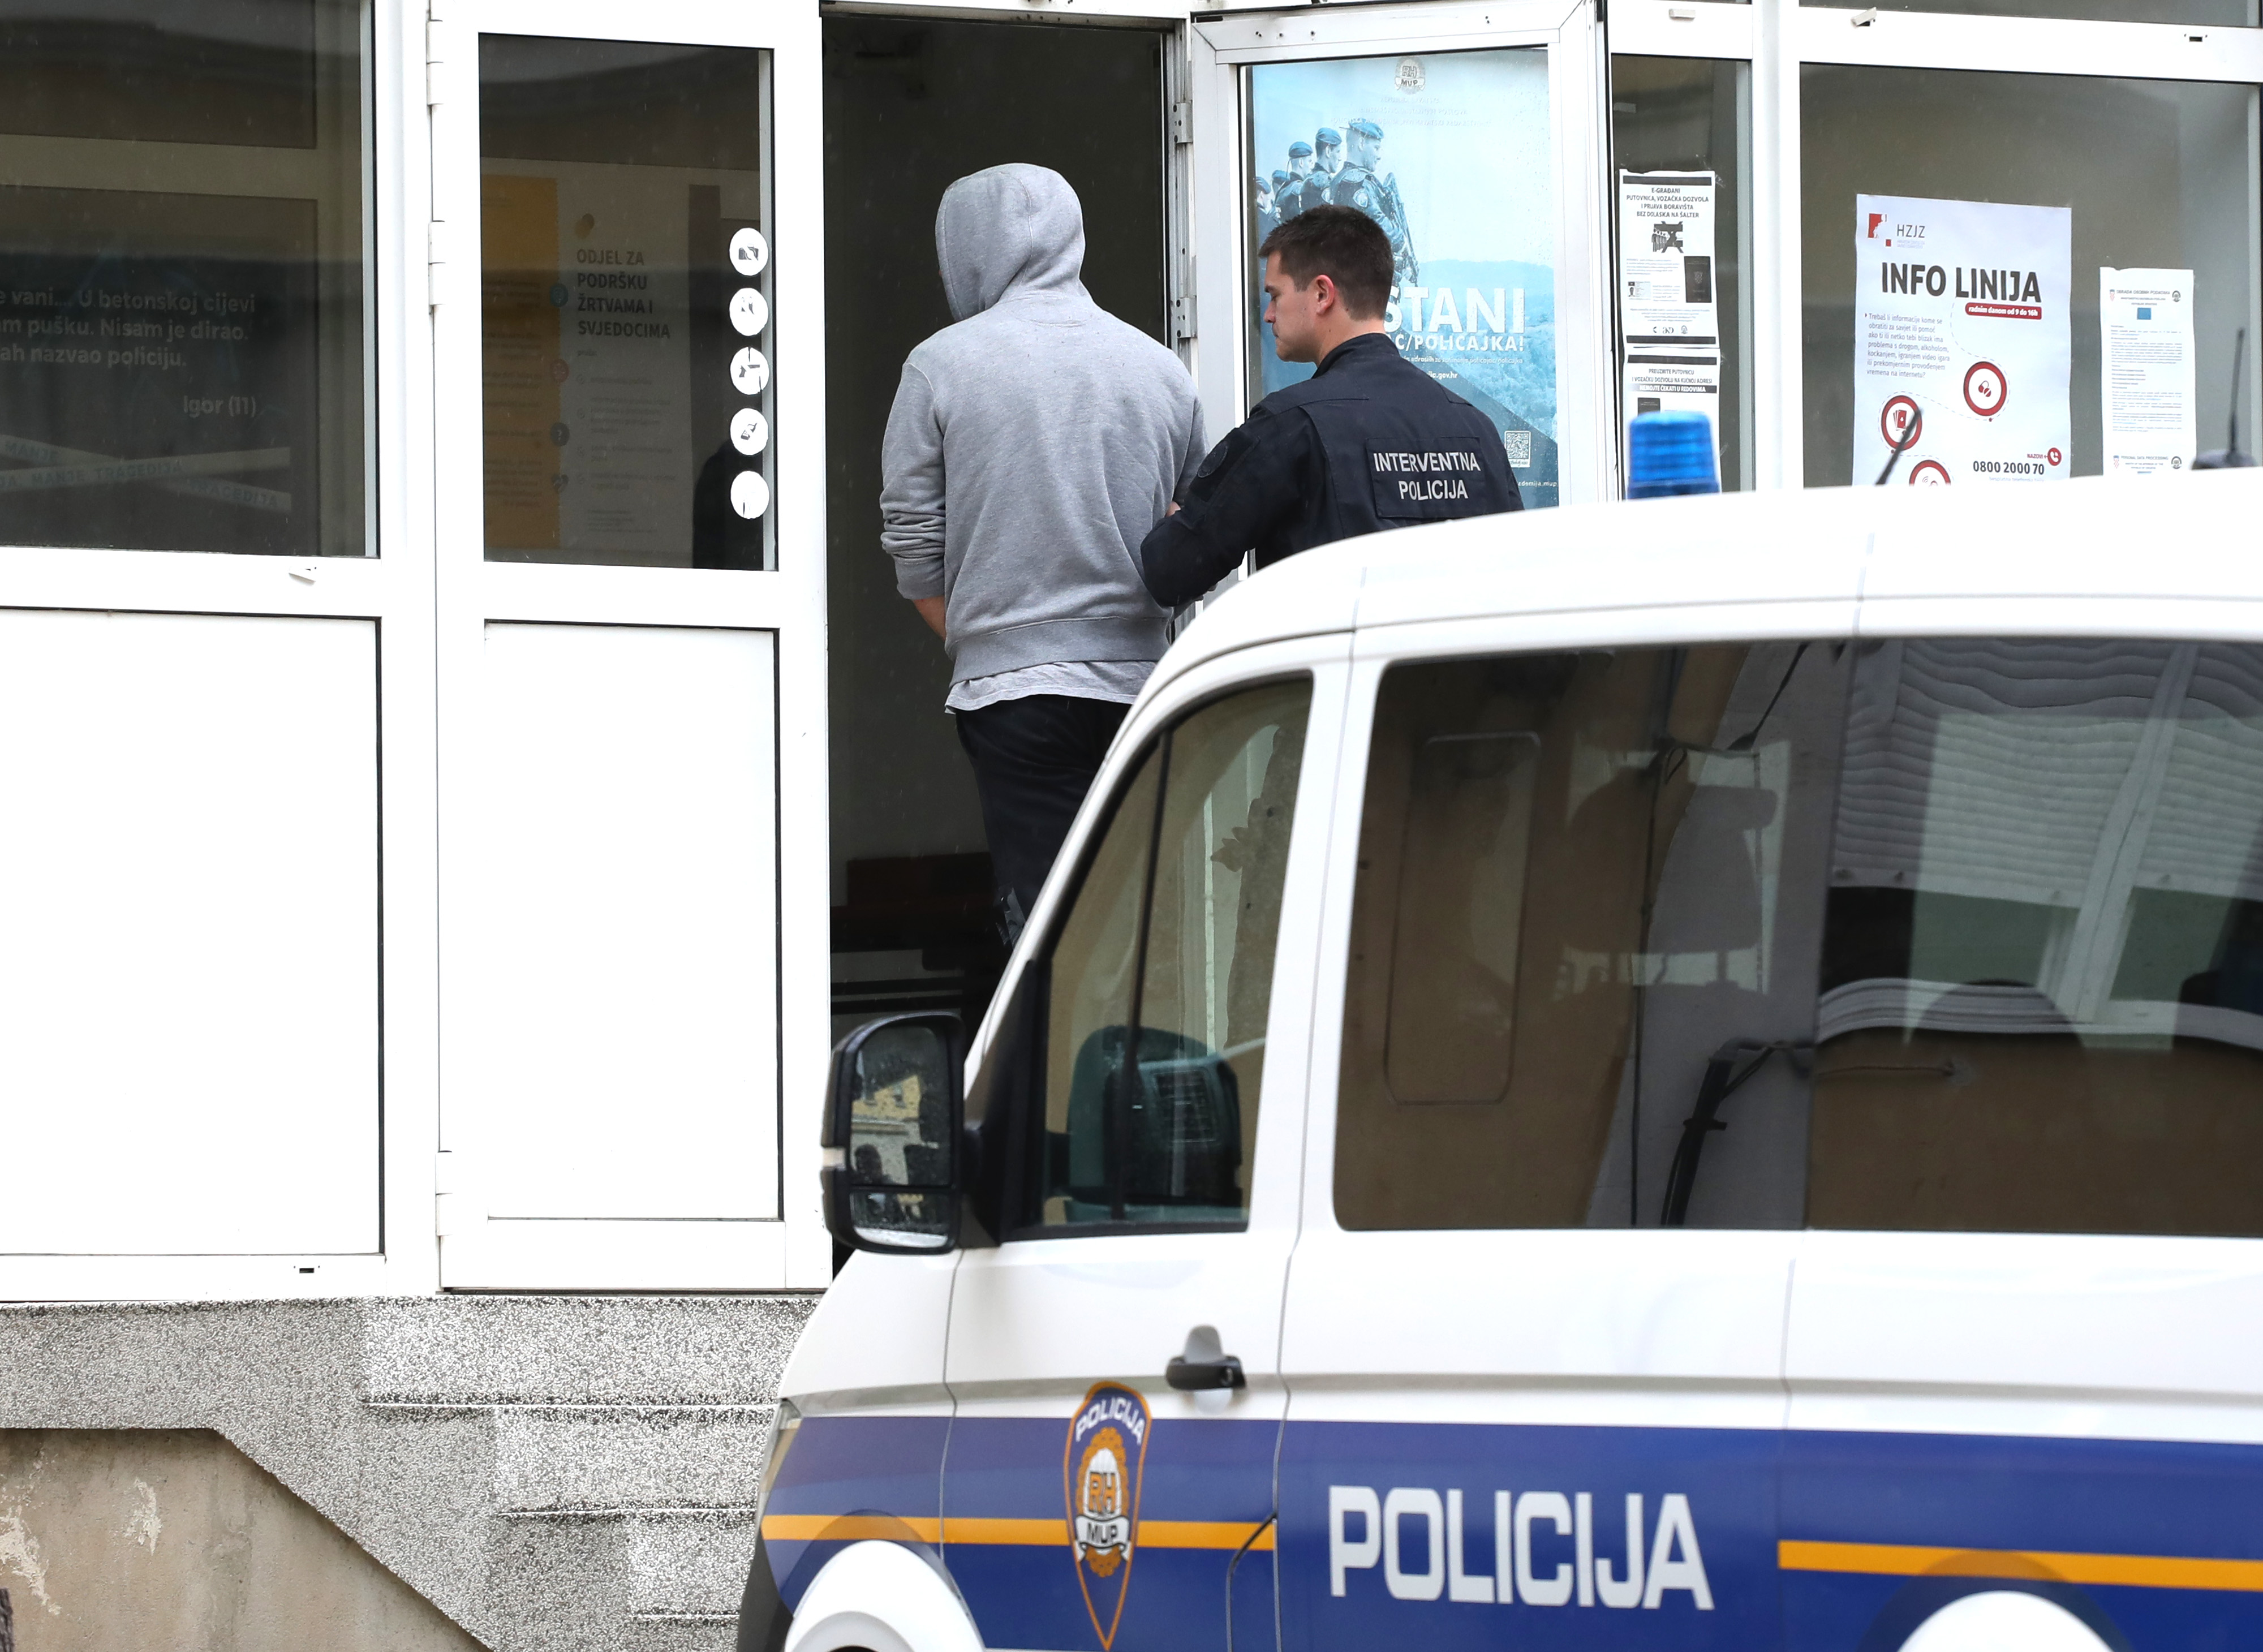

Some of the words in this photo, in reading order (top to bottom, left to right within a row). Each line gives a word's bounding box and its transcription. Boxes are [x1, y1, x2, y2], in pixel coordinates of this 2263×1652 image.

[1401, 65, 1417, 78] RH
[1896, 223, 1925, 238] HZJZ
[576, 248, 622, 265] ODJEL
[626, 251, 644, 266] ZA
[578, 270, 647, 290] PODRŠKU
[1881, 262, 1947, 296] INFO
[1956, 267, 2042, 303] LINIJA
[79, 289, 92, 307] U
[99, 290, 198, 316] betonskoj
[203, 291, 255, 317] cijevi
[578, 292, 645, 313] ŽRTVAMA
[649, 300, 653, 314] I
[28, 315, 94, 338] pušku.
[100, 318, 164, 338] Nisam
[166, 319, 186, 342] je
[190, 320, 248, 341] dirao.
[578, 320, 671, 339] SVJEDOCIMA
[1892, 315, 1920, 324] informacije
[1868, 350, 1897, 359] kockanjem,
[1898, 342, 1920, 351] drogom,
[31, 348, 102, 363] nazvao
[107, 345, 187, 371] policiju.
[1873, 360, 1910, 368] prekomjernim
[183, 395, 224, 418] Igor
[1374, 452, 1481, 472] INTERVENTNA
[1973, 461, 2000, 472] 0800
[2003, 462, 2030, 474] 2000
[2033, 463, 2045, 475] 70
[1398, 479, 1469, 501] POLICIJA
[1075, 1395, 1146, 1446] POLICIJA
[1088, 1471, 1116, 1514] RH
[1086, 1522, 1118, 1545] MUP
[1328, 1485, 1715, 1611] POLICIJA
